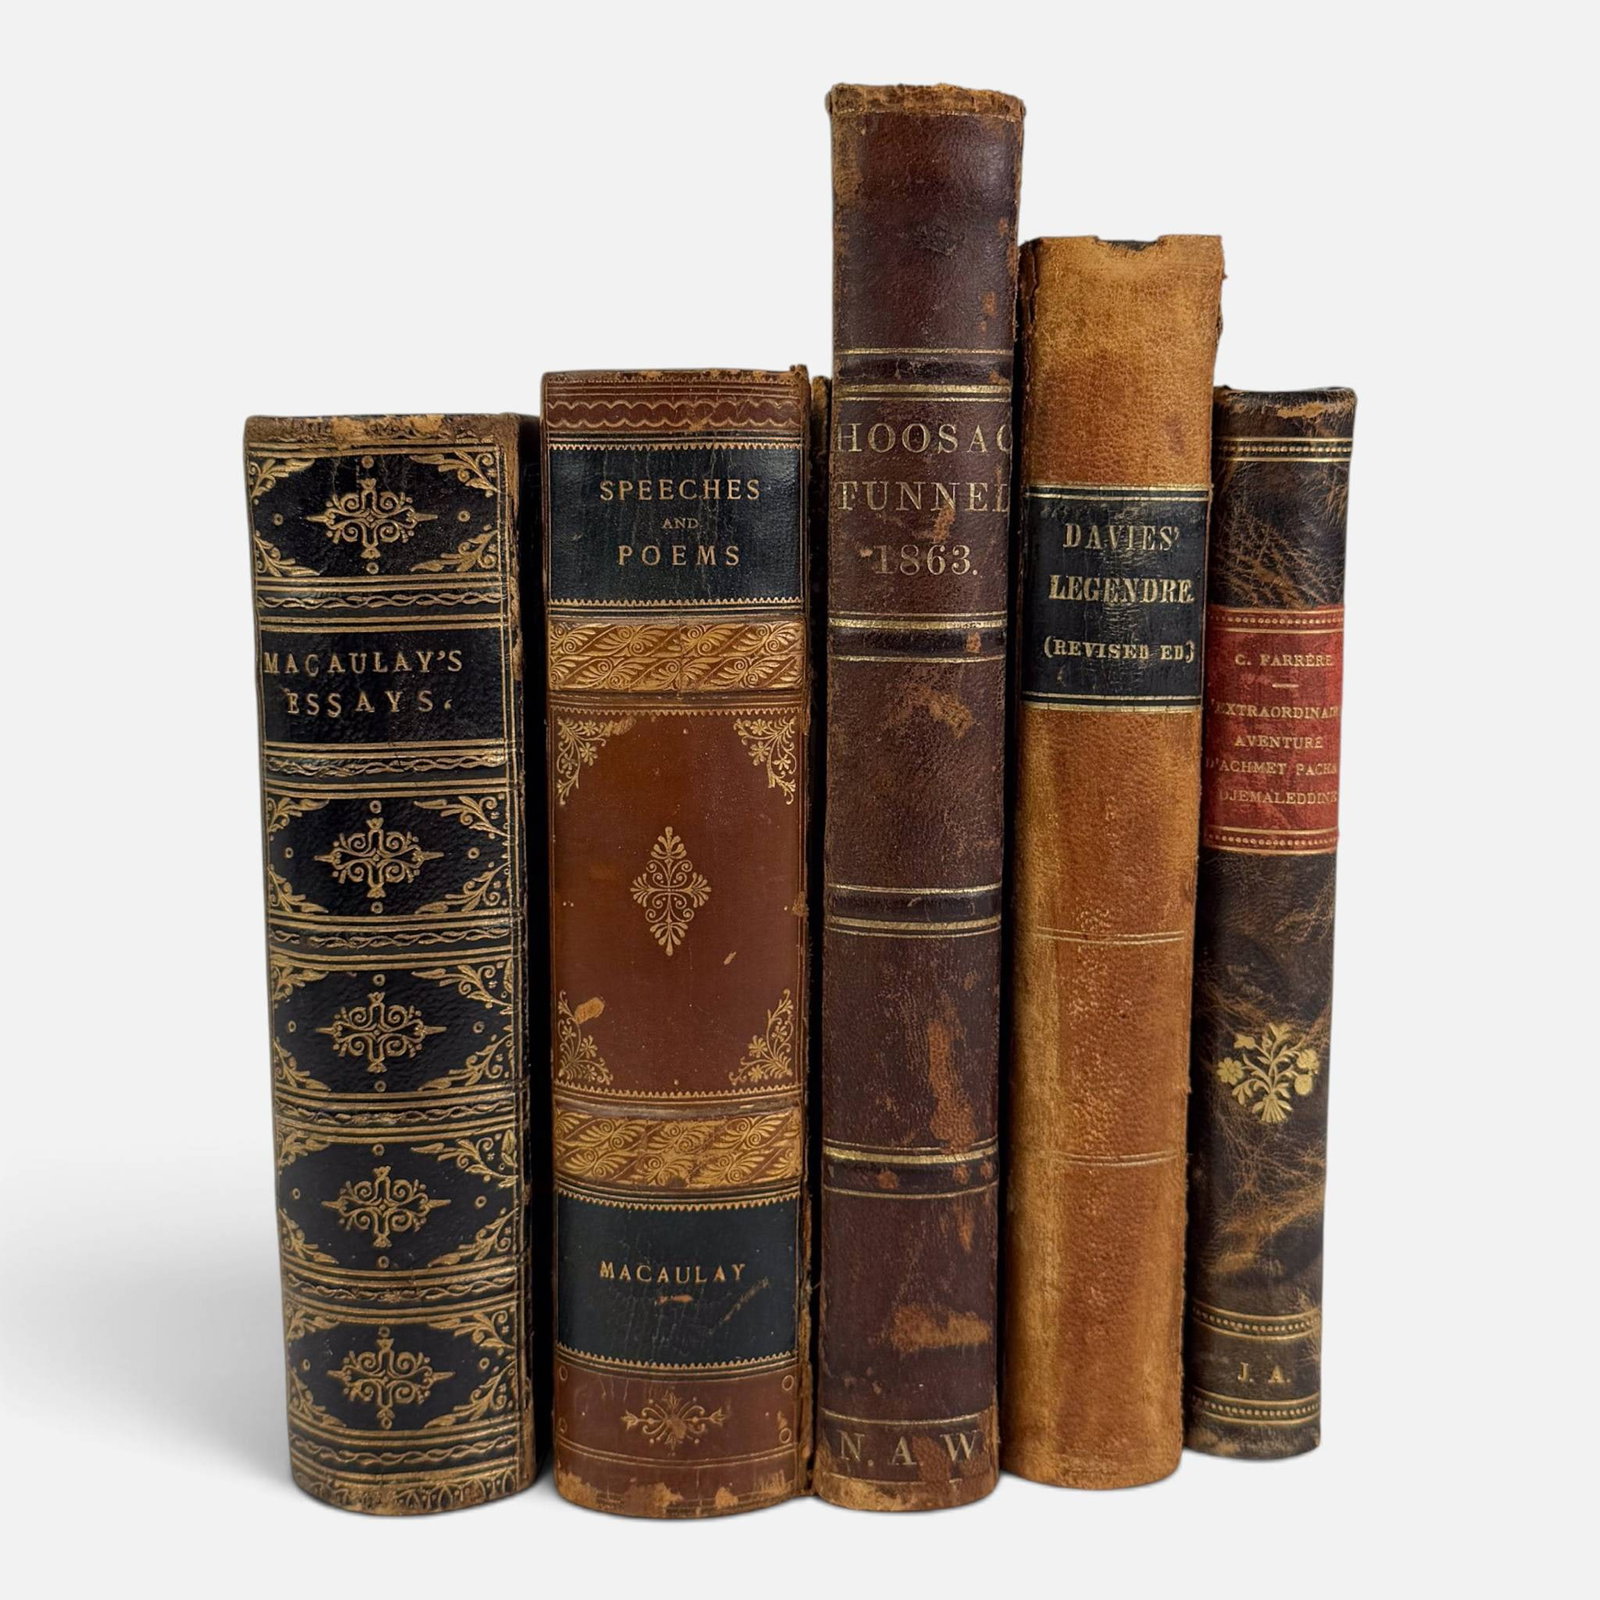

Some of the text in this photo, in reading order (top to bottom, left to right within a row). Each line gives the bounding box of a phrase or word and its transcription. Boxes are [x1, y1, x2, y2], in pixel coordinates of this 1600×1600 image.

[836, 422, 1012, 453] HOOSAC
[599, 478, 761, 501] SPEECHES
[835, 480, 1010, 512] TUNNEL
[662, 517, 699, 530] AND
[1062, 522, 1181, 551] DAVIES'
[617, 544, 740, 567] POEMS
[873, 544, 978, 576] 1863.
[1043, 635, 1150, 661] (REVISED
[1234, 654, 1252, 666] C.
[263, 650, 463, 677] MACAULAY'S
[1233, 734, 1324, 749] AVENTURE
[599, 1260, 746, 1284] MACAULAY
[1237, 1361, 1291, 1384] J. A.
[837, 1429, 875, 1467] N.
